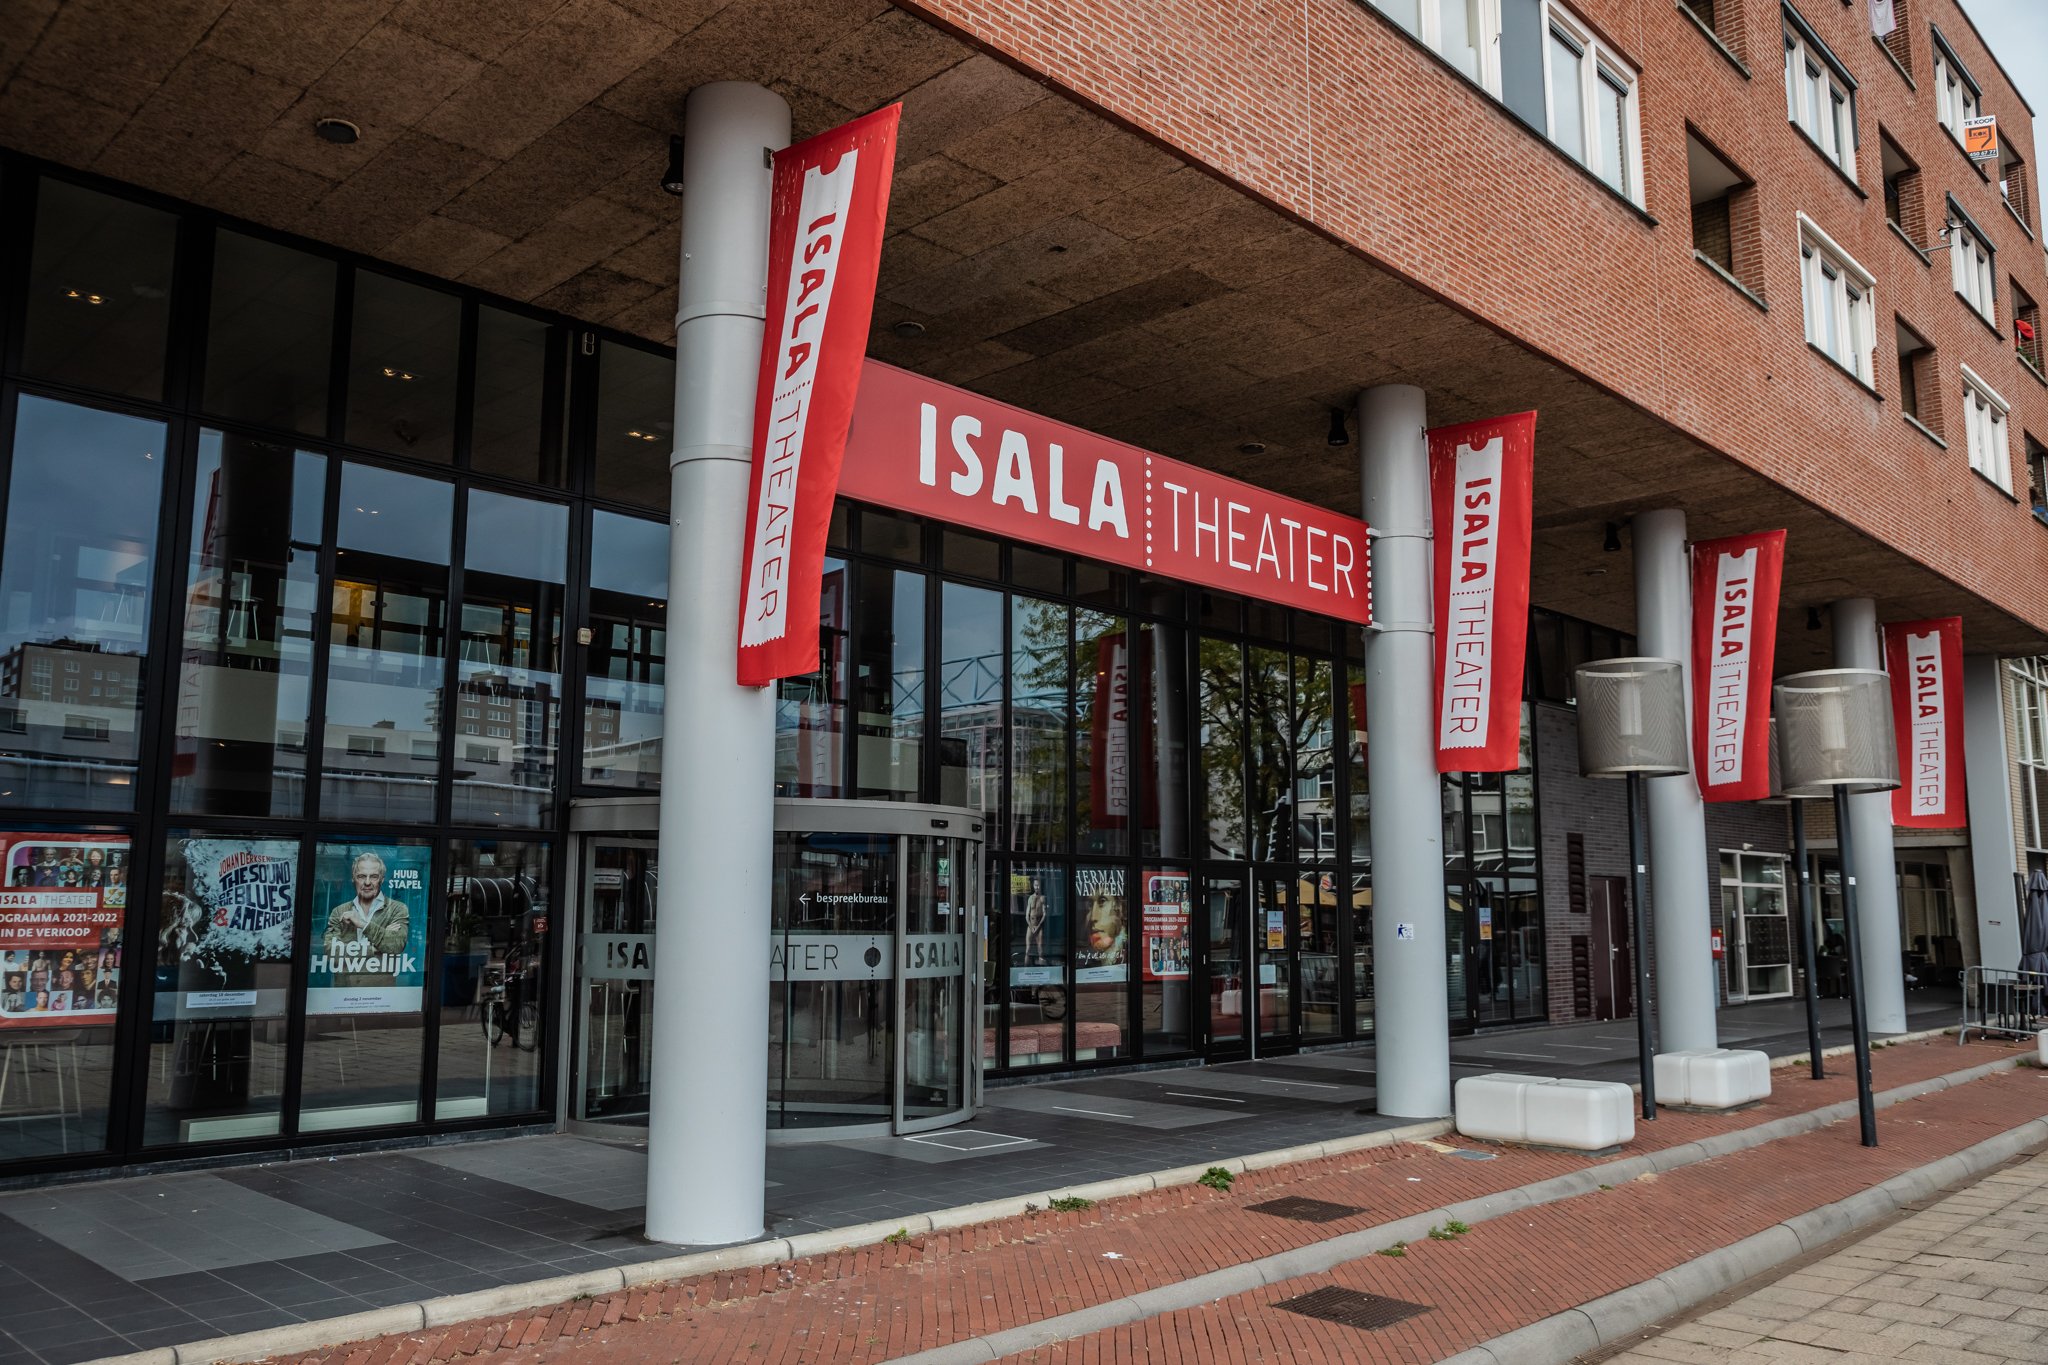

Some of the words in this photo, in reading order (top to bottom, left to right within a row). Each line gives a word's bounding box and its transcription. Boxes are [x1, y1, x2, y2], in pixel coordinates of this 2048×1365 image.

[784, 212, 837, 381] ISALA
[759, 400, 801, 622] THEATER
[920, 403, 1129, 538] ISALA
[1164, 481, 1355, 598] THEATER
[1461, 477, 1492, 584] ISALA
[1720, 578, 1748, 658] ISALA
[1449, 600, 1486, 734] THEATER
[1916, 655, 1938, 718] ISALA
[1714, 670, 1741, 774] THEATER
[1919, 727, 1938, 808] THEATER
[219, 852, 239, 876] JOHAN
[240, 851, 271, 866] DERKSEN
[219, 866, 248, 891] THE
[249, 861, 291, 885] SOUND
[393, 869, 418, 879] HUUB
[1076, 870, 1125, 884] HERMAN
[235, 884, 292, 912] BLUES
[388, 879, 422, 889] STAPEL
[45, 895, 93, 905] THEATER
[816, 893, 888, 905] bespreekbureau
[0, 913, 60, 923] OGRAMMA
[63, 913, 117, 922] 2021-2022
[213, 907, 228, 927] &
[229, 906, 293, 931] AMERICANA
[1, 928, 14, 938] IN
[17, 928, 33, 938] DE
[36, 928, 91, 937] VERKOOP
[330, 937, 370, 957] het
[310, 953, 417, 977] Huwelijk
[607, 942, 650, 969] ISA
[770, 944, 838, 971] ATER
[905, 941, 960, 969] ISALA
